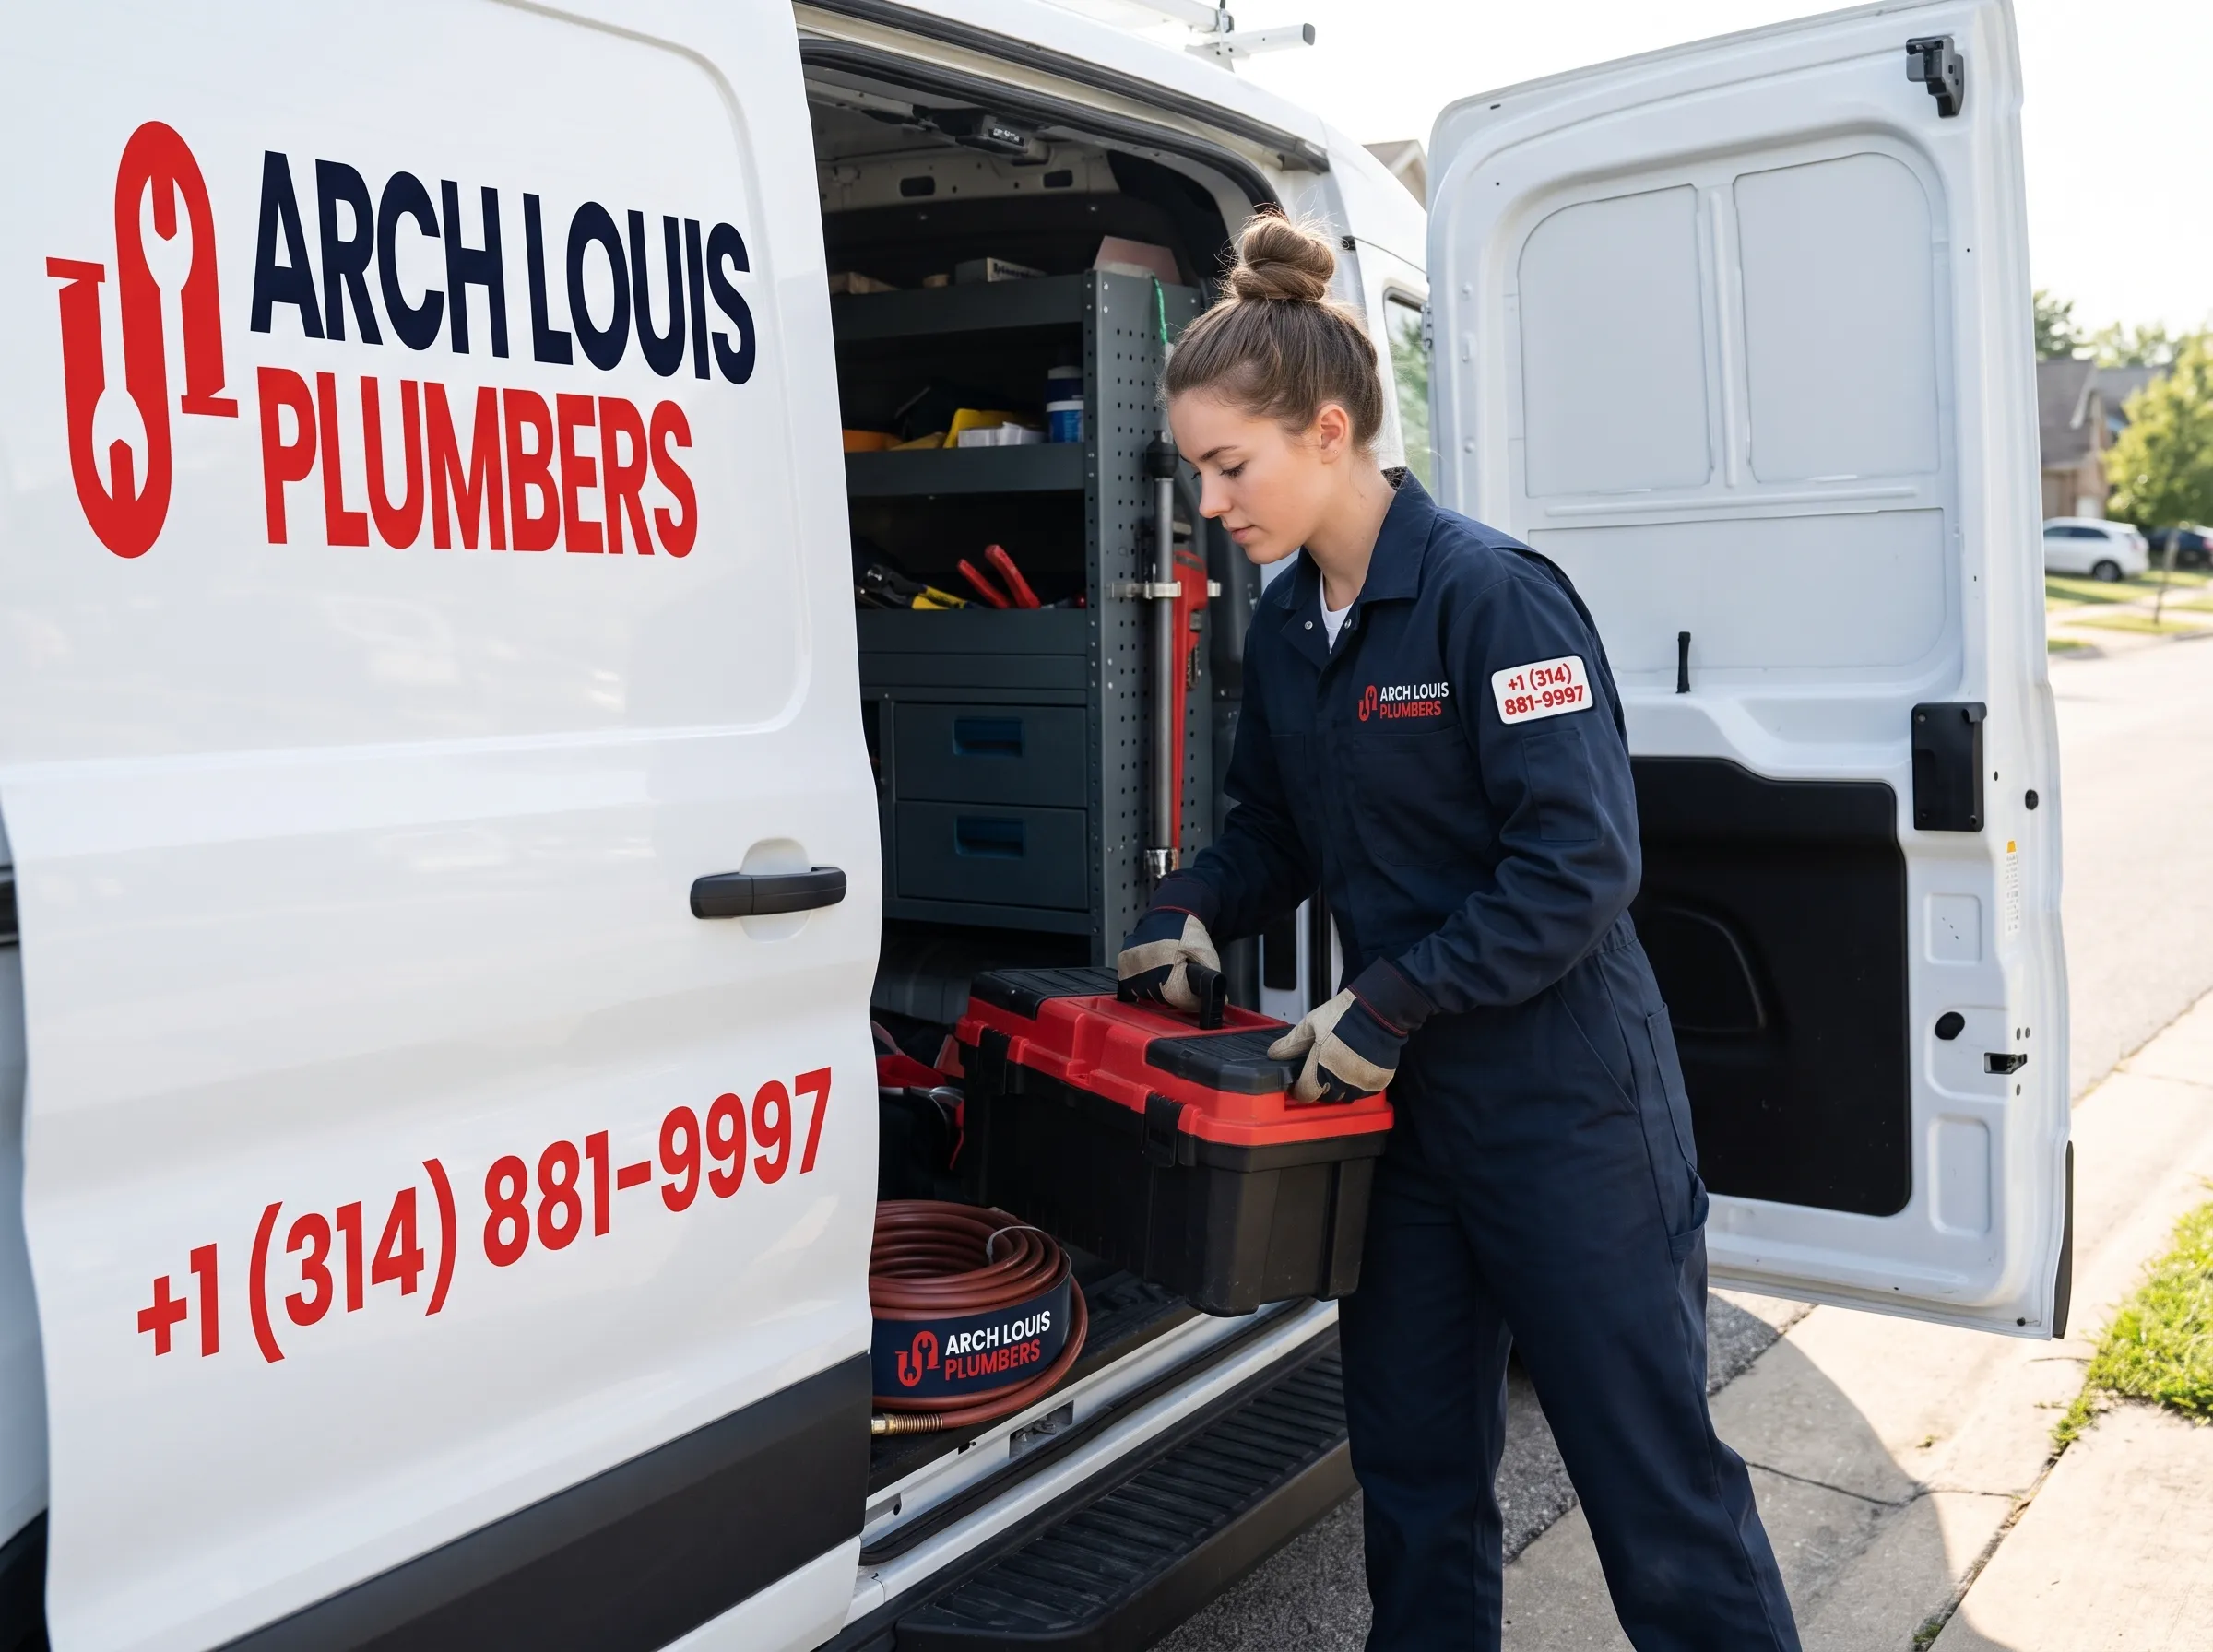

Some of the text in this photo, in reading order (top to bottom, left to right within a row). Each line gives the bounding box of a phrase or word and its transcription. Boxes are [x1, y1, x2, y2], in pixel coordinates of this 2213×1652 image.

[250, 149, 756, 385] ARCH LOUIS
[256, 366, 698, 559] PLUMBERS
[1379, 681, 1450, 701] ARCH LOUIS
[1508, 663, 1572, 691] +1 (314)
[1379, 701, 1442, 718] PLUMBERS
[1504, 684, 1584, 716] 881-9997
[137, 1067, 832, 1363] +1 (314) 881-9997
[945, 1310, 1051, 1356] ARCH LOUIS
[945, 1339, 1041, 1380] PLUMBERS
